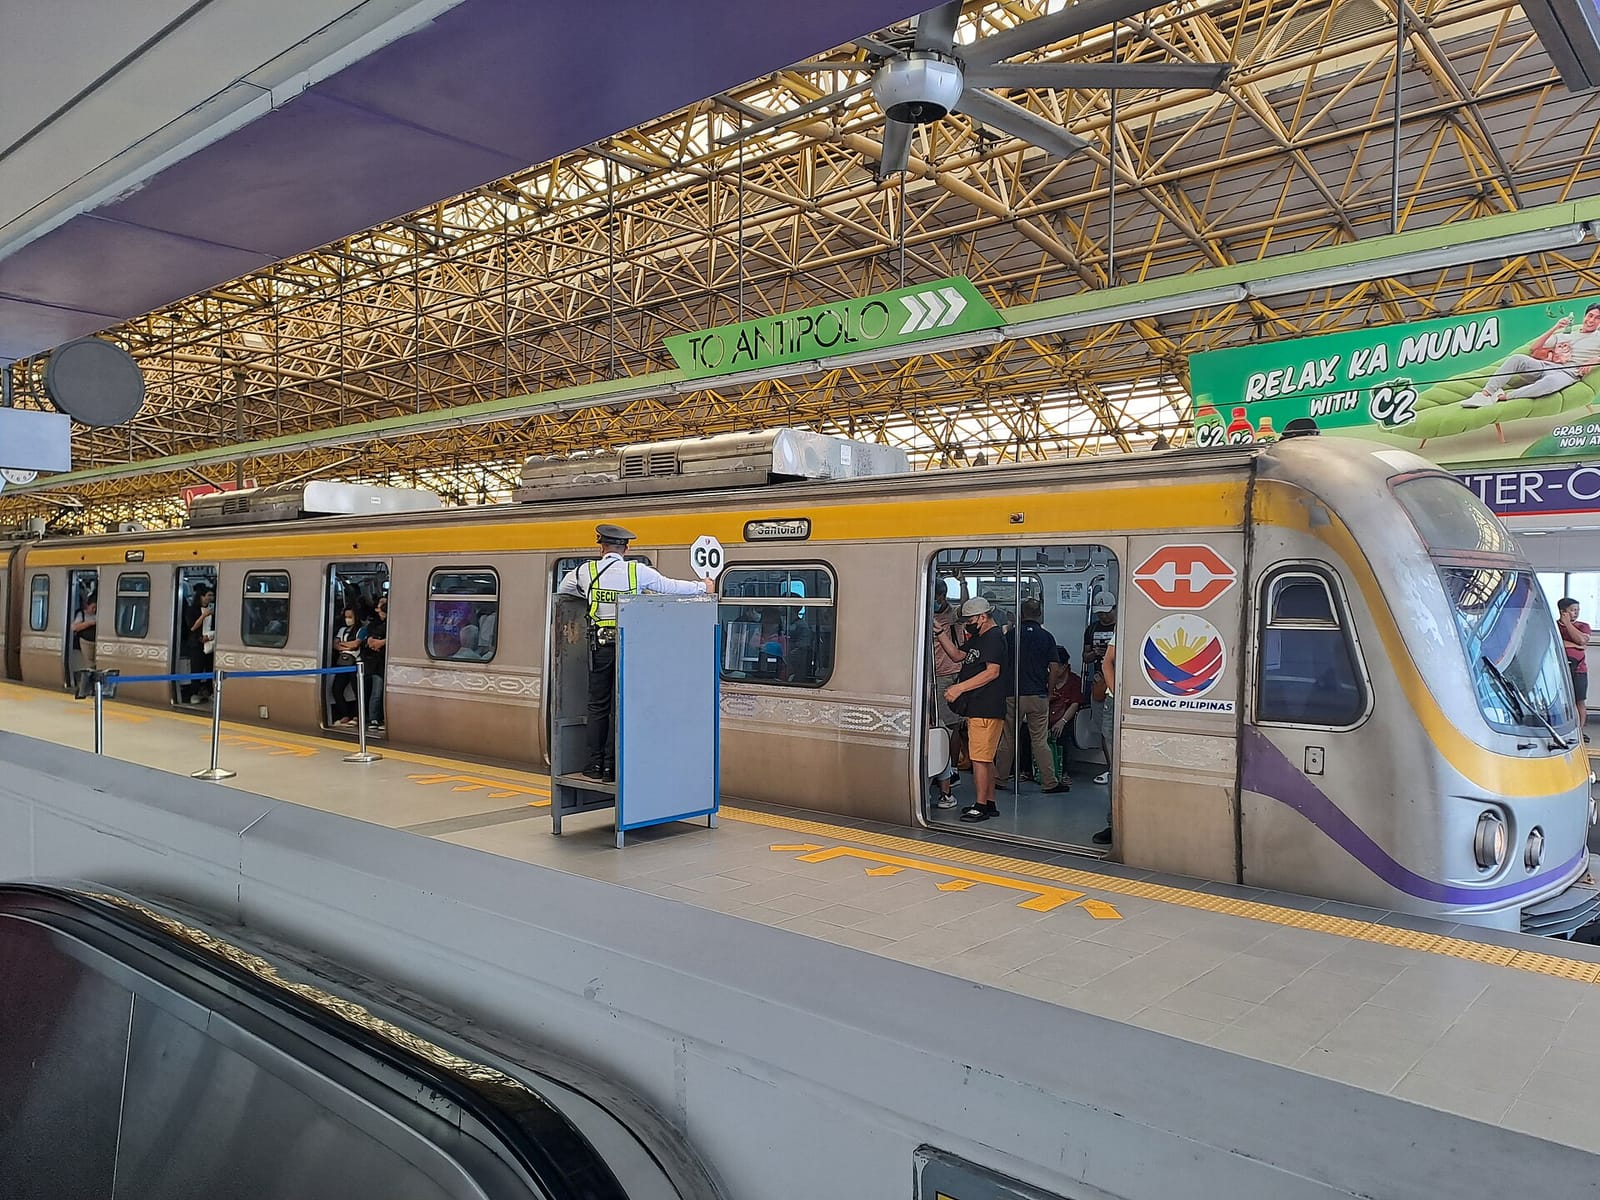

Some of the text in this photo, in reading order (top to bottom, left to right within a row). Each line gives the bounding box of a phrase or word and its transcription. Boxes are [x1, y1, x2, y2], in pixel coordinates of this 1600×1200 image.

[688, 300, 889, 370] TO ANTIPOLO
[1245, 317, 1500, 403] RELAX KA MUNA
[1310, 387, 1417, 424] WITH C2
[1552, 425, 1583, 437] GRAB
[1559, 436, 1587, 448] NOW
[695, 547, 721, 568] GO
[1132, 698, 1233, 711] BAGONG PILIPINAS
